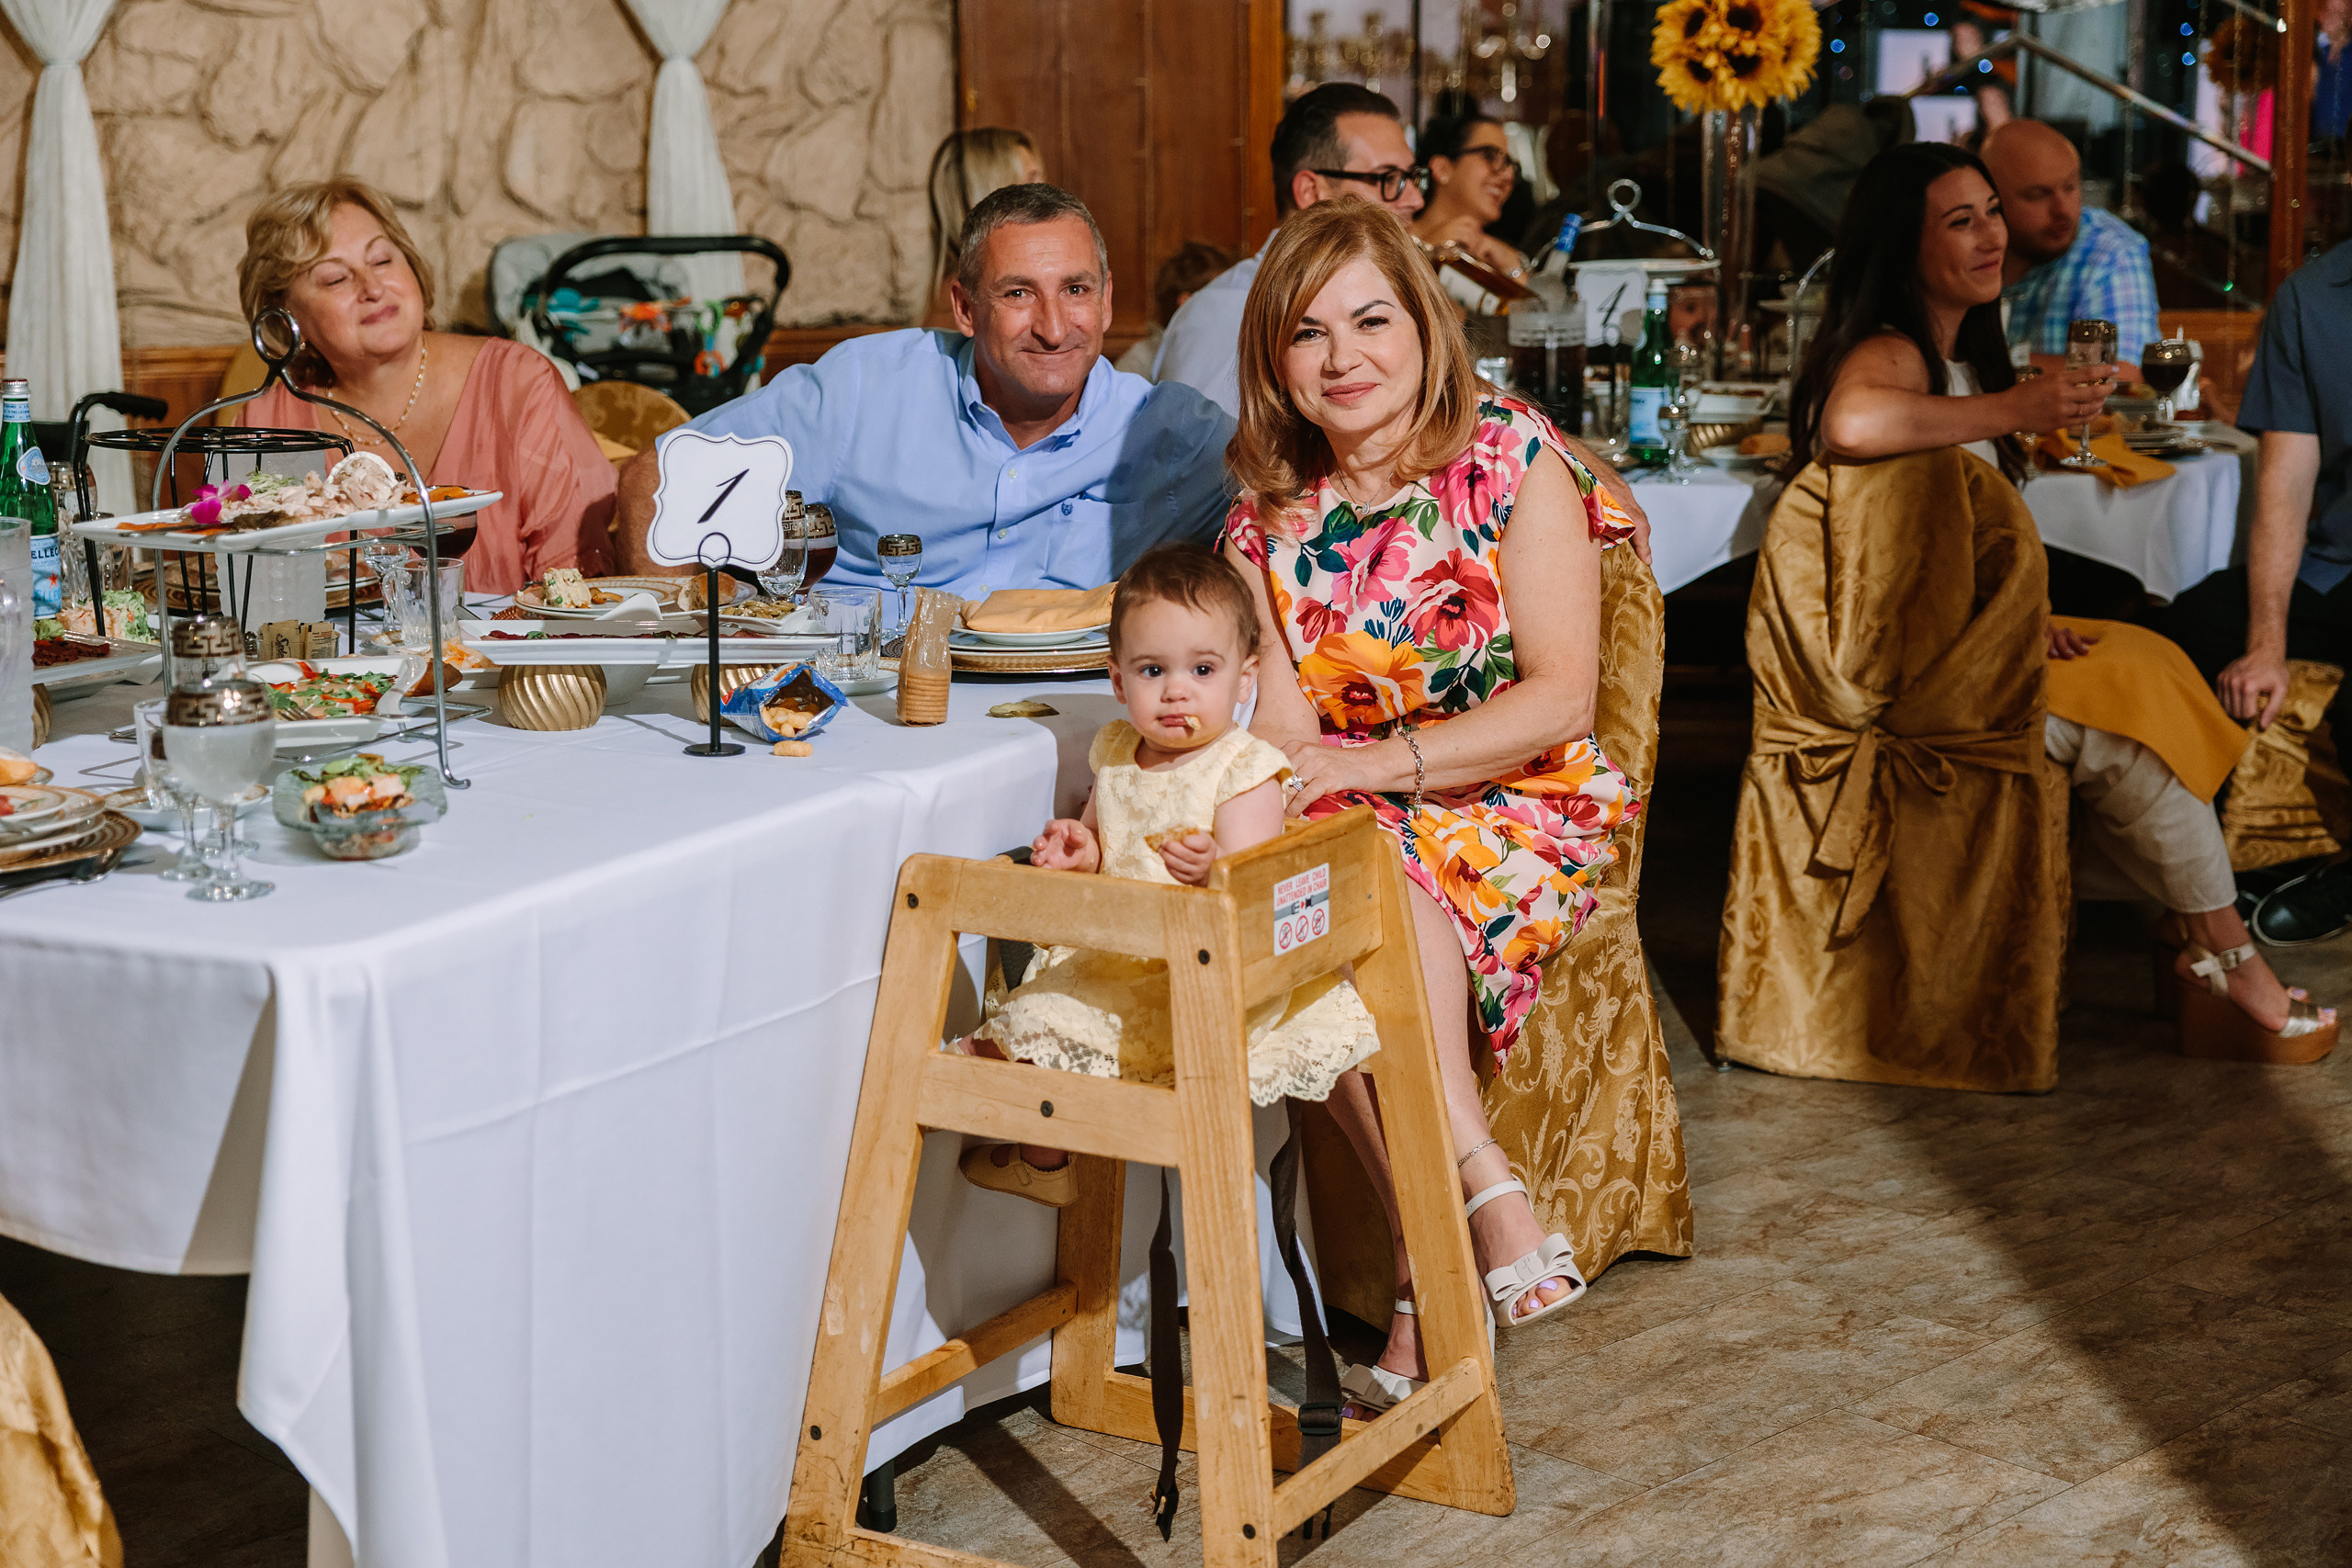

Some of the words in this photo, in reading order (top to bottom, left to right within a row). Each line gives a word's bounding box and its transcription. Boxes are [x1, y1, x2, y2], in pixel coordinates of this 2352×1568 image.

[1597, 280, 1631, 328] 4
[696, 468, 751, 525] 1
[1276, 886, 1306, 907] UNATTENDED
[1306, 884, 1312, 894] IN
[1313, 877, 1328, 892] CHAIR
[1277, 881, 1293, 895] NEVER
[1295, 874, 1309, 888] LEAVE
[1312, 867, 1326, 882] CHILD
